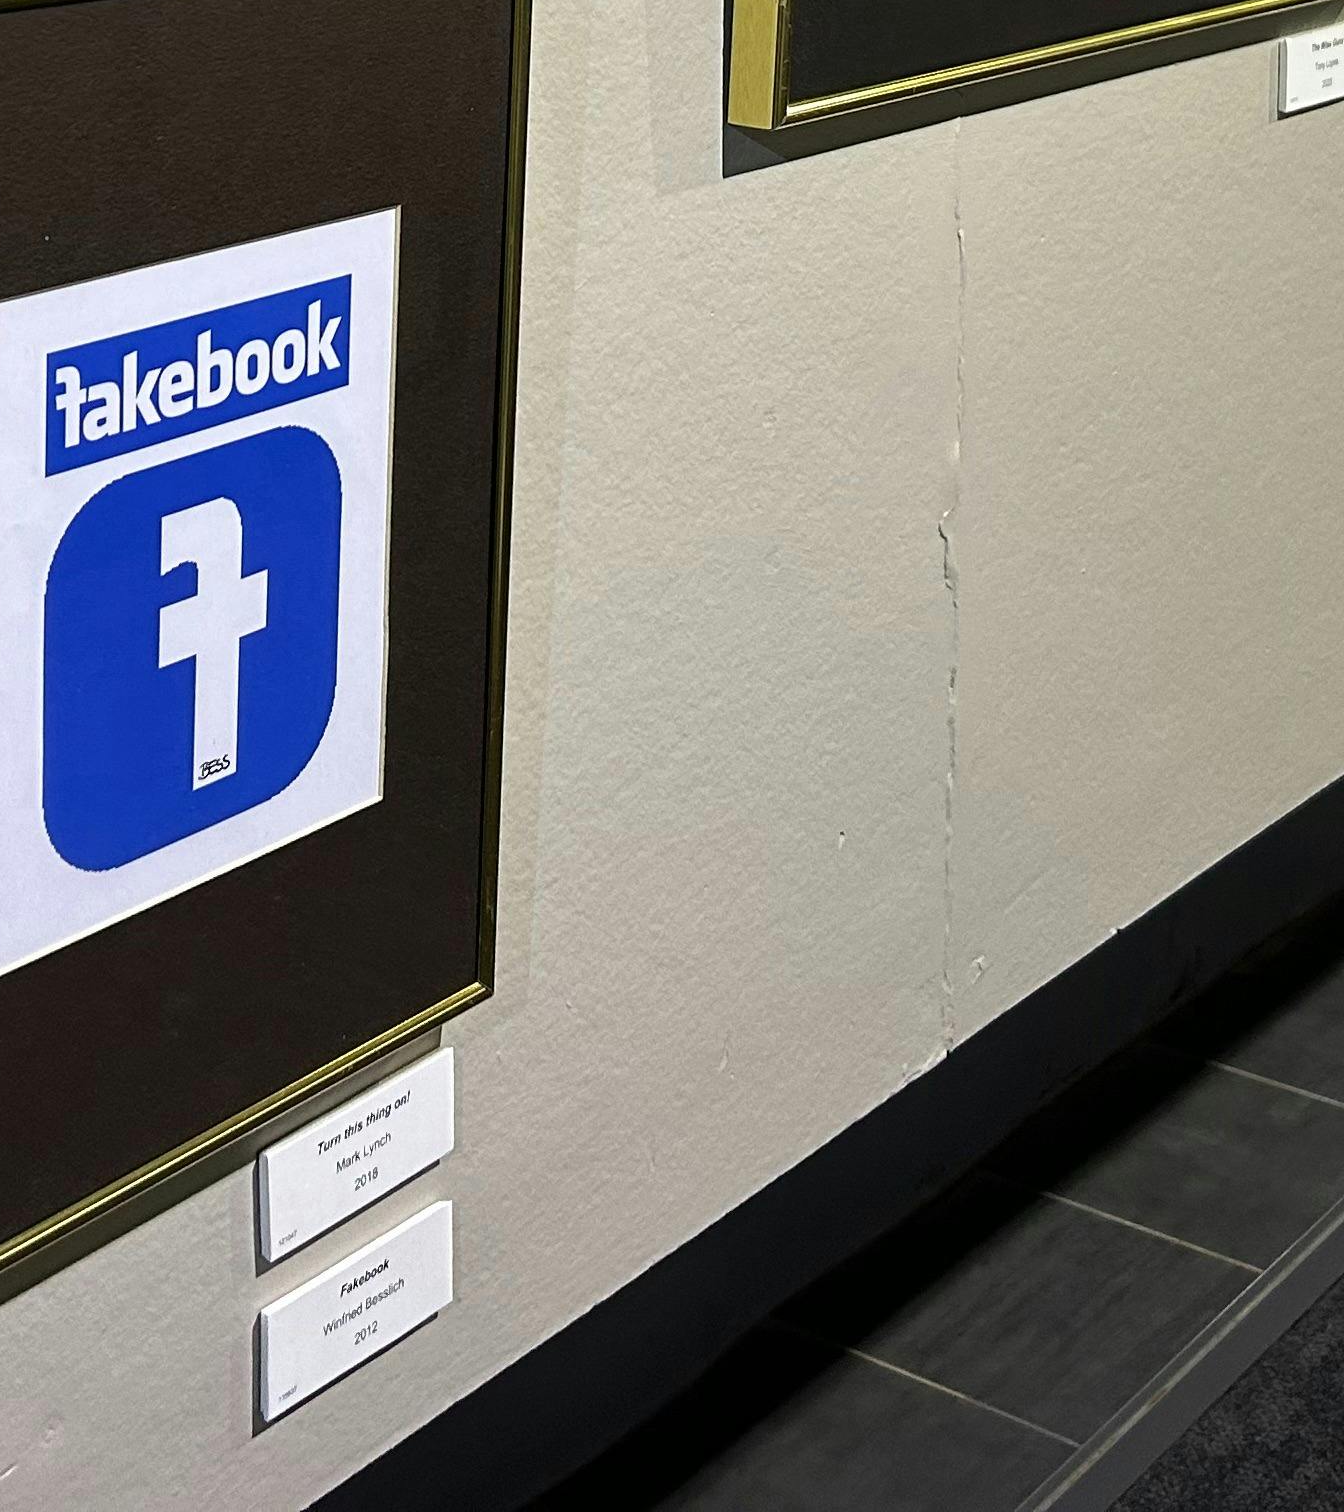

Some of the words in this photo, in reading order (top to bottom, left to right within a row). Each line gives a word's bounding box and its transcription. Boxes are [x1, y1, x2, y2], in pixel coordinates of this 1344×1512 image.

[317, 1135, 341, 1156] Turn
[344, 1119, 363, 1140] this
[366, 1102, 392, 1129] thing
[394, 1089, 411, 1110] on!
[336, 1153, 361, 1175] Mark
[363, 1131, 392, 1157] Lynch
[354, 1166, 379, 1192] 2018
[340, 1258, 390, 1298] Fakebook
[322, 1303, 363, 1337] Winfried
[365, 1278, 405, 1310] Besslich
[354, 1320, 379, 1346] 2012
